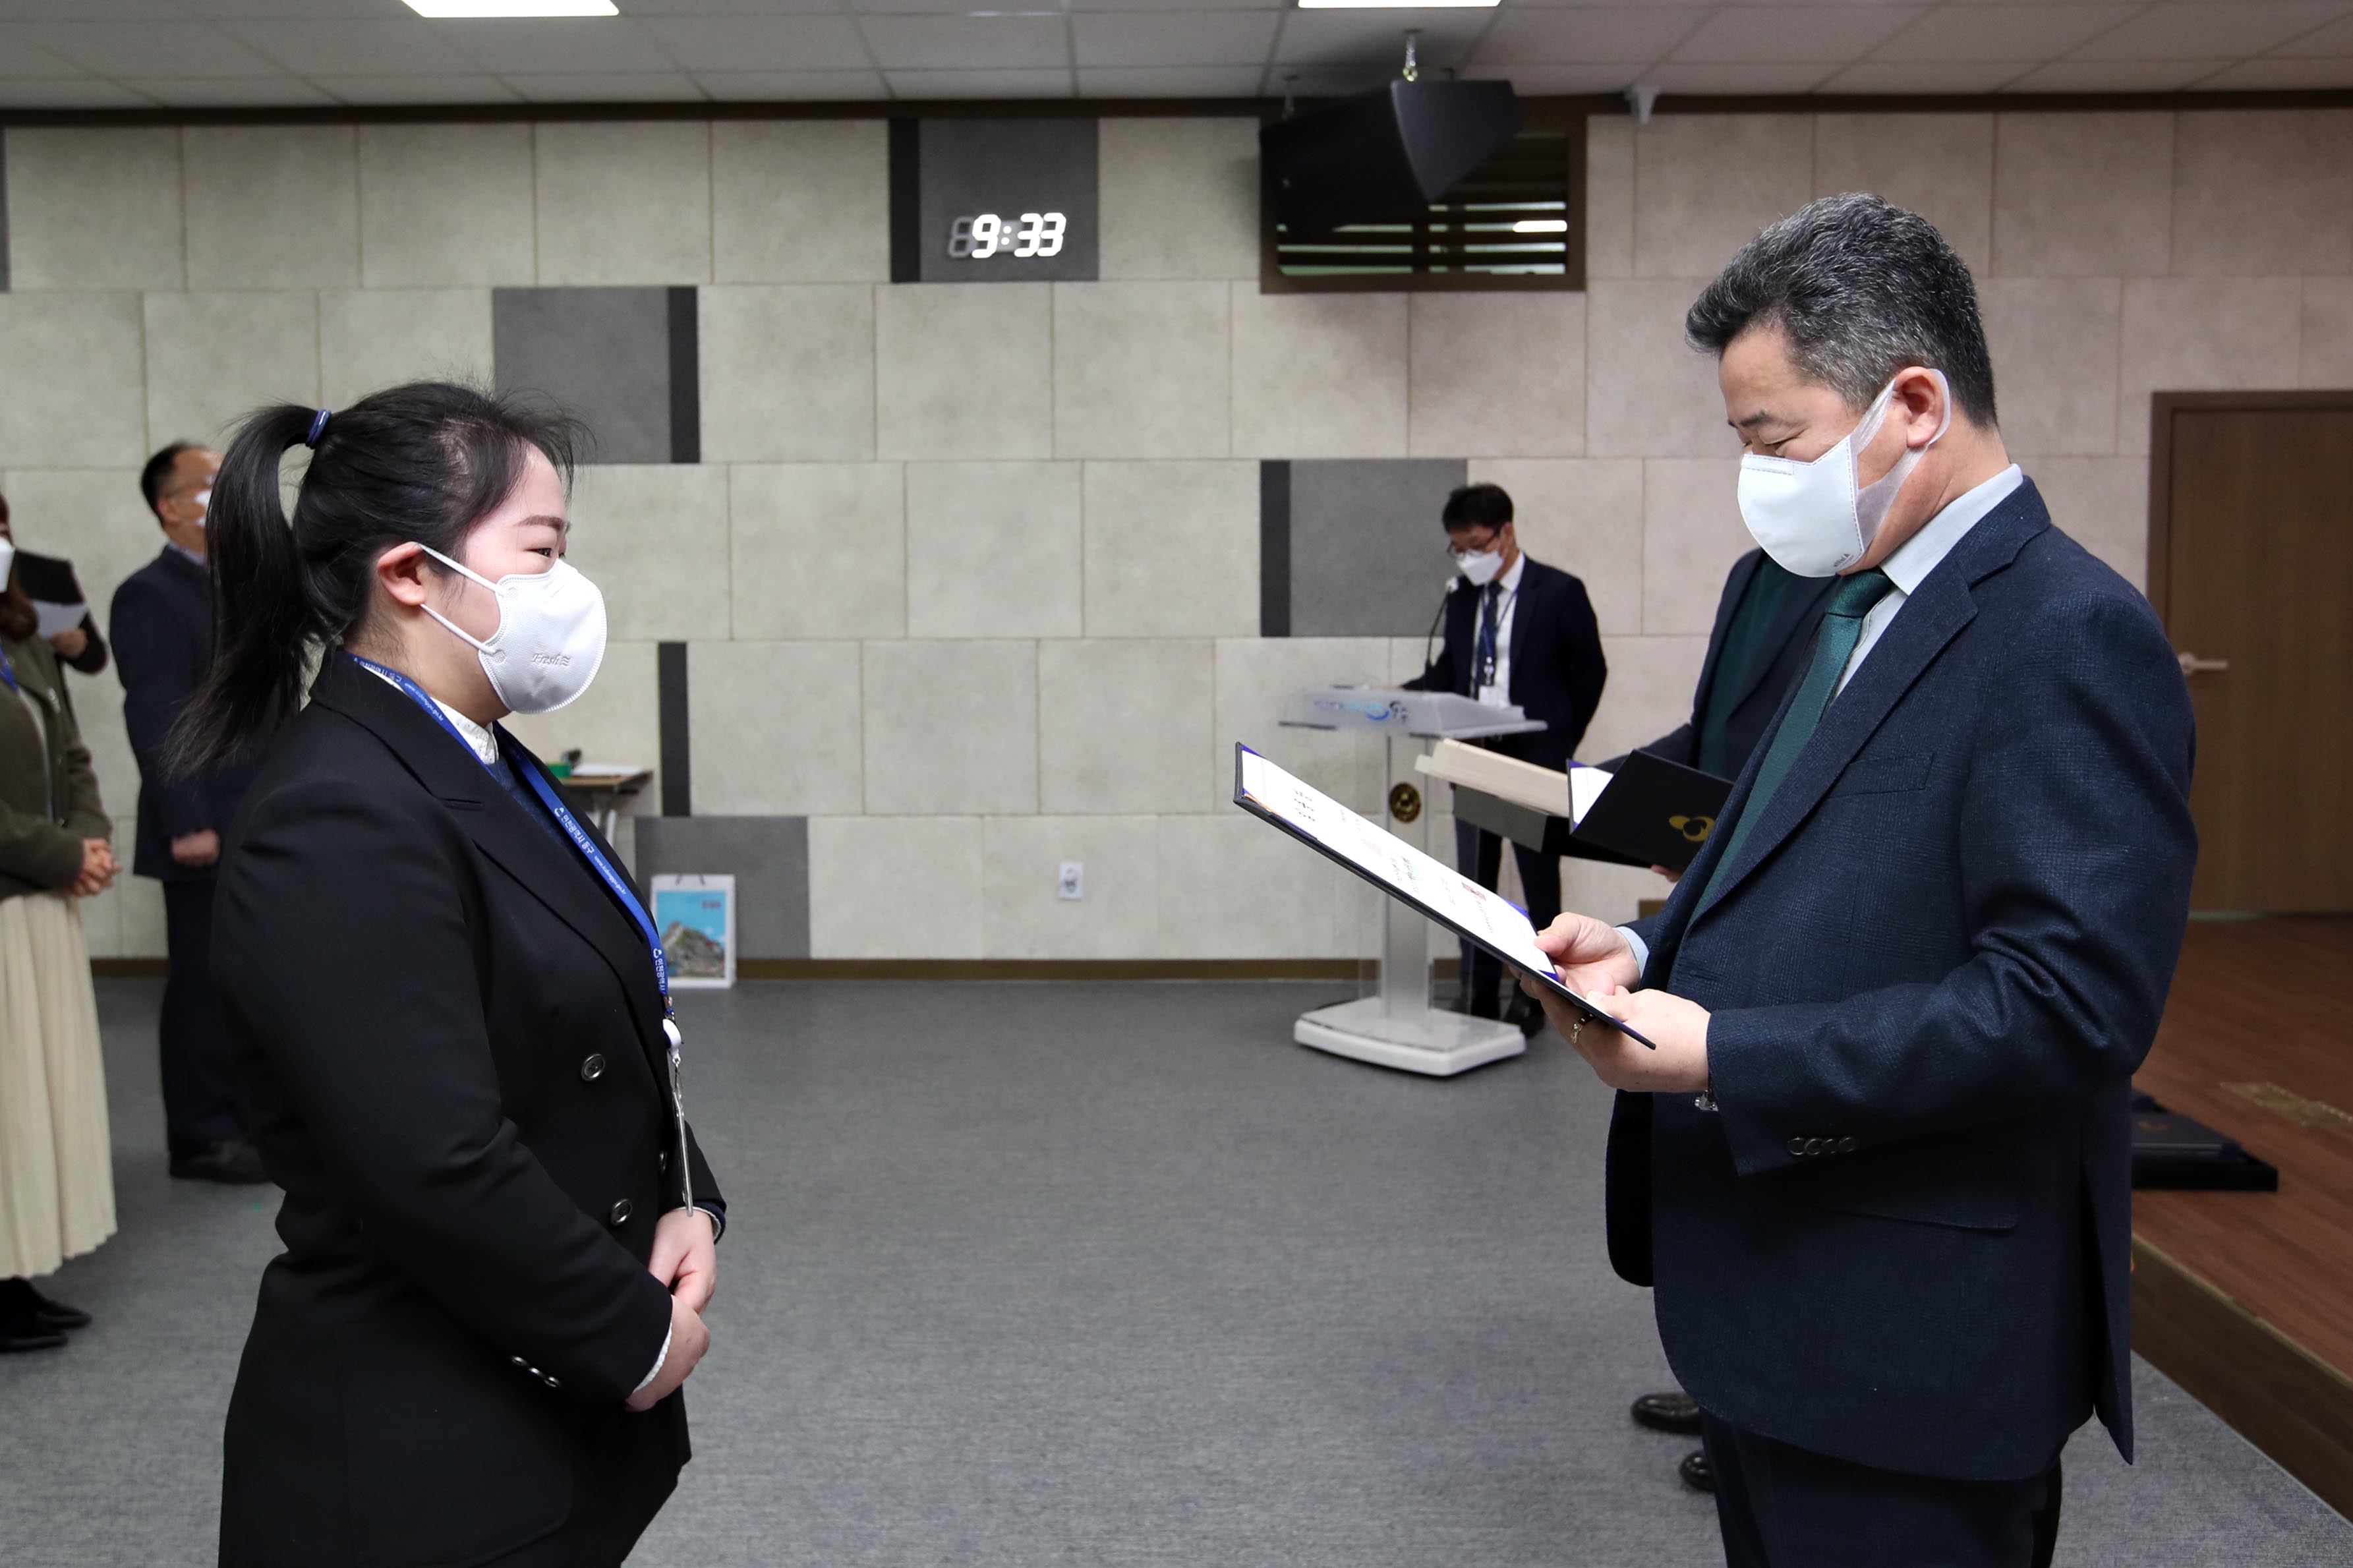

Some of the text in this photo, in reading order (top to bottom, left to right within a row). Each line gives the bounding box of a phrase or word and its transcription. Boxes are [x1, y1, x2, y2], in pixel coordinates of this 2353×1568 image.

[972, 212, 1066, 258] 9:33
[561, 815, 585, 844] 인천광역시
[581, 841, 595, 854] 동구
[655, 958, 665, 991] 인천광역시
